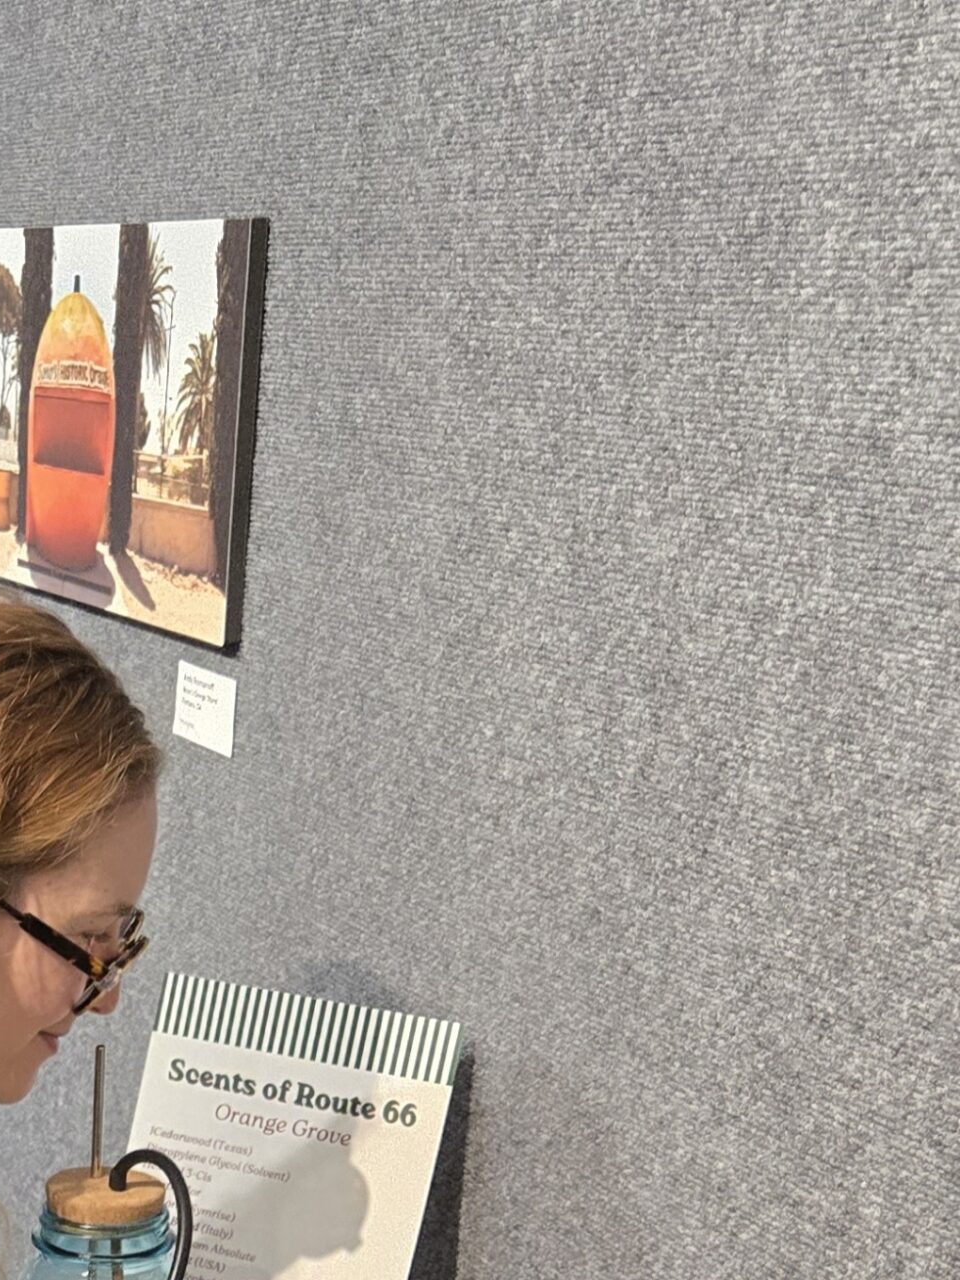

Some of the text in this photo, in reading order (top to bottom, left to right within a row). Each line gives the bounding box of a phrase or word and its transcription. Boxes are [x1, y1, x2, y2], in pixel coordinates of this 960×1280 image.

[168, 1058, 418, 1128] Scents of Route 66
[215, 1104, 352, 1147] Orange Grove
[213, 1137, 253, 1157] (Texas)
[208, 1156, 241, 1173] Glycol
[241, 1163, 292, 1183] (Solvent)
[200, 1224, 235, 1241] (Italy)
[210, 1243, 257, 1263] Absolute
[194, 1256, 227, 1274] (USA)
